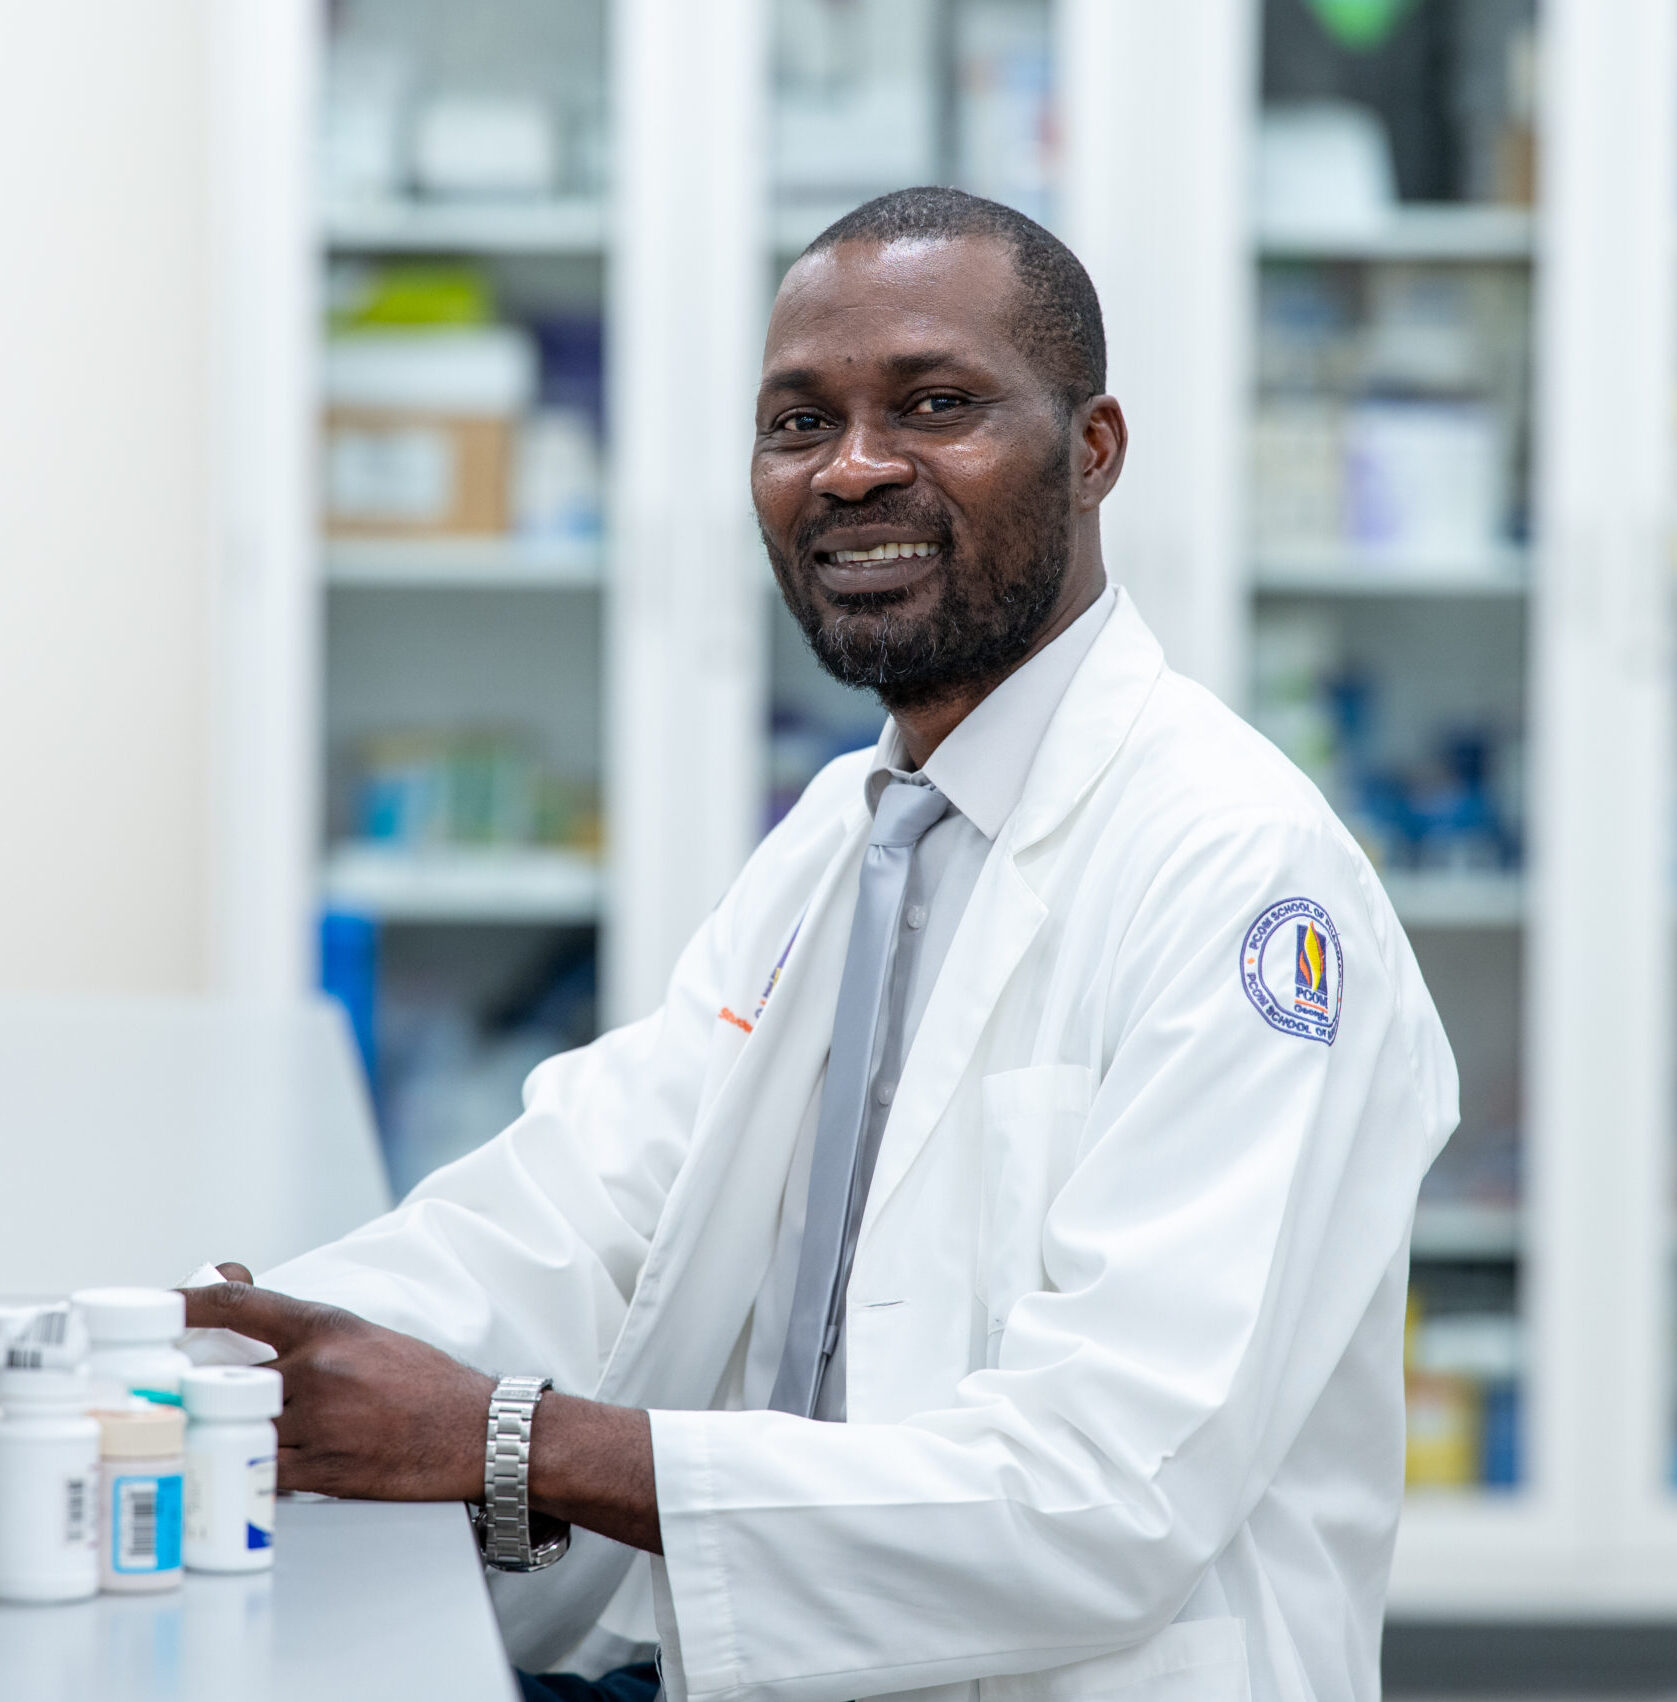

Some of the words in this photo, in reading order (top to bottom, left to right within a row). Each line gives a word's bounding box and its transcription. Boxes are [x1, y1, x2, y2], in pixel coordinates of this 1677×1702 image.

[1248, 916, 1273, 950] PCOM
[1270, 902, 1312, 920] SCHOOL
[1247, 972, 1270, 1007] PCOM
[1266, 1005, 1312, 1034] SCHOOL
[1296, 986, 1328, 1009] PCOM
